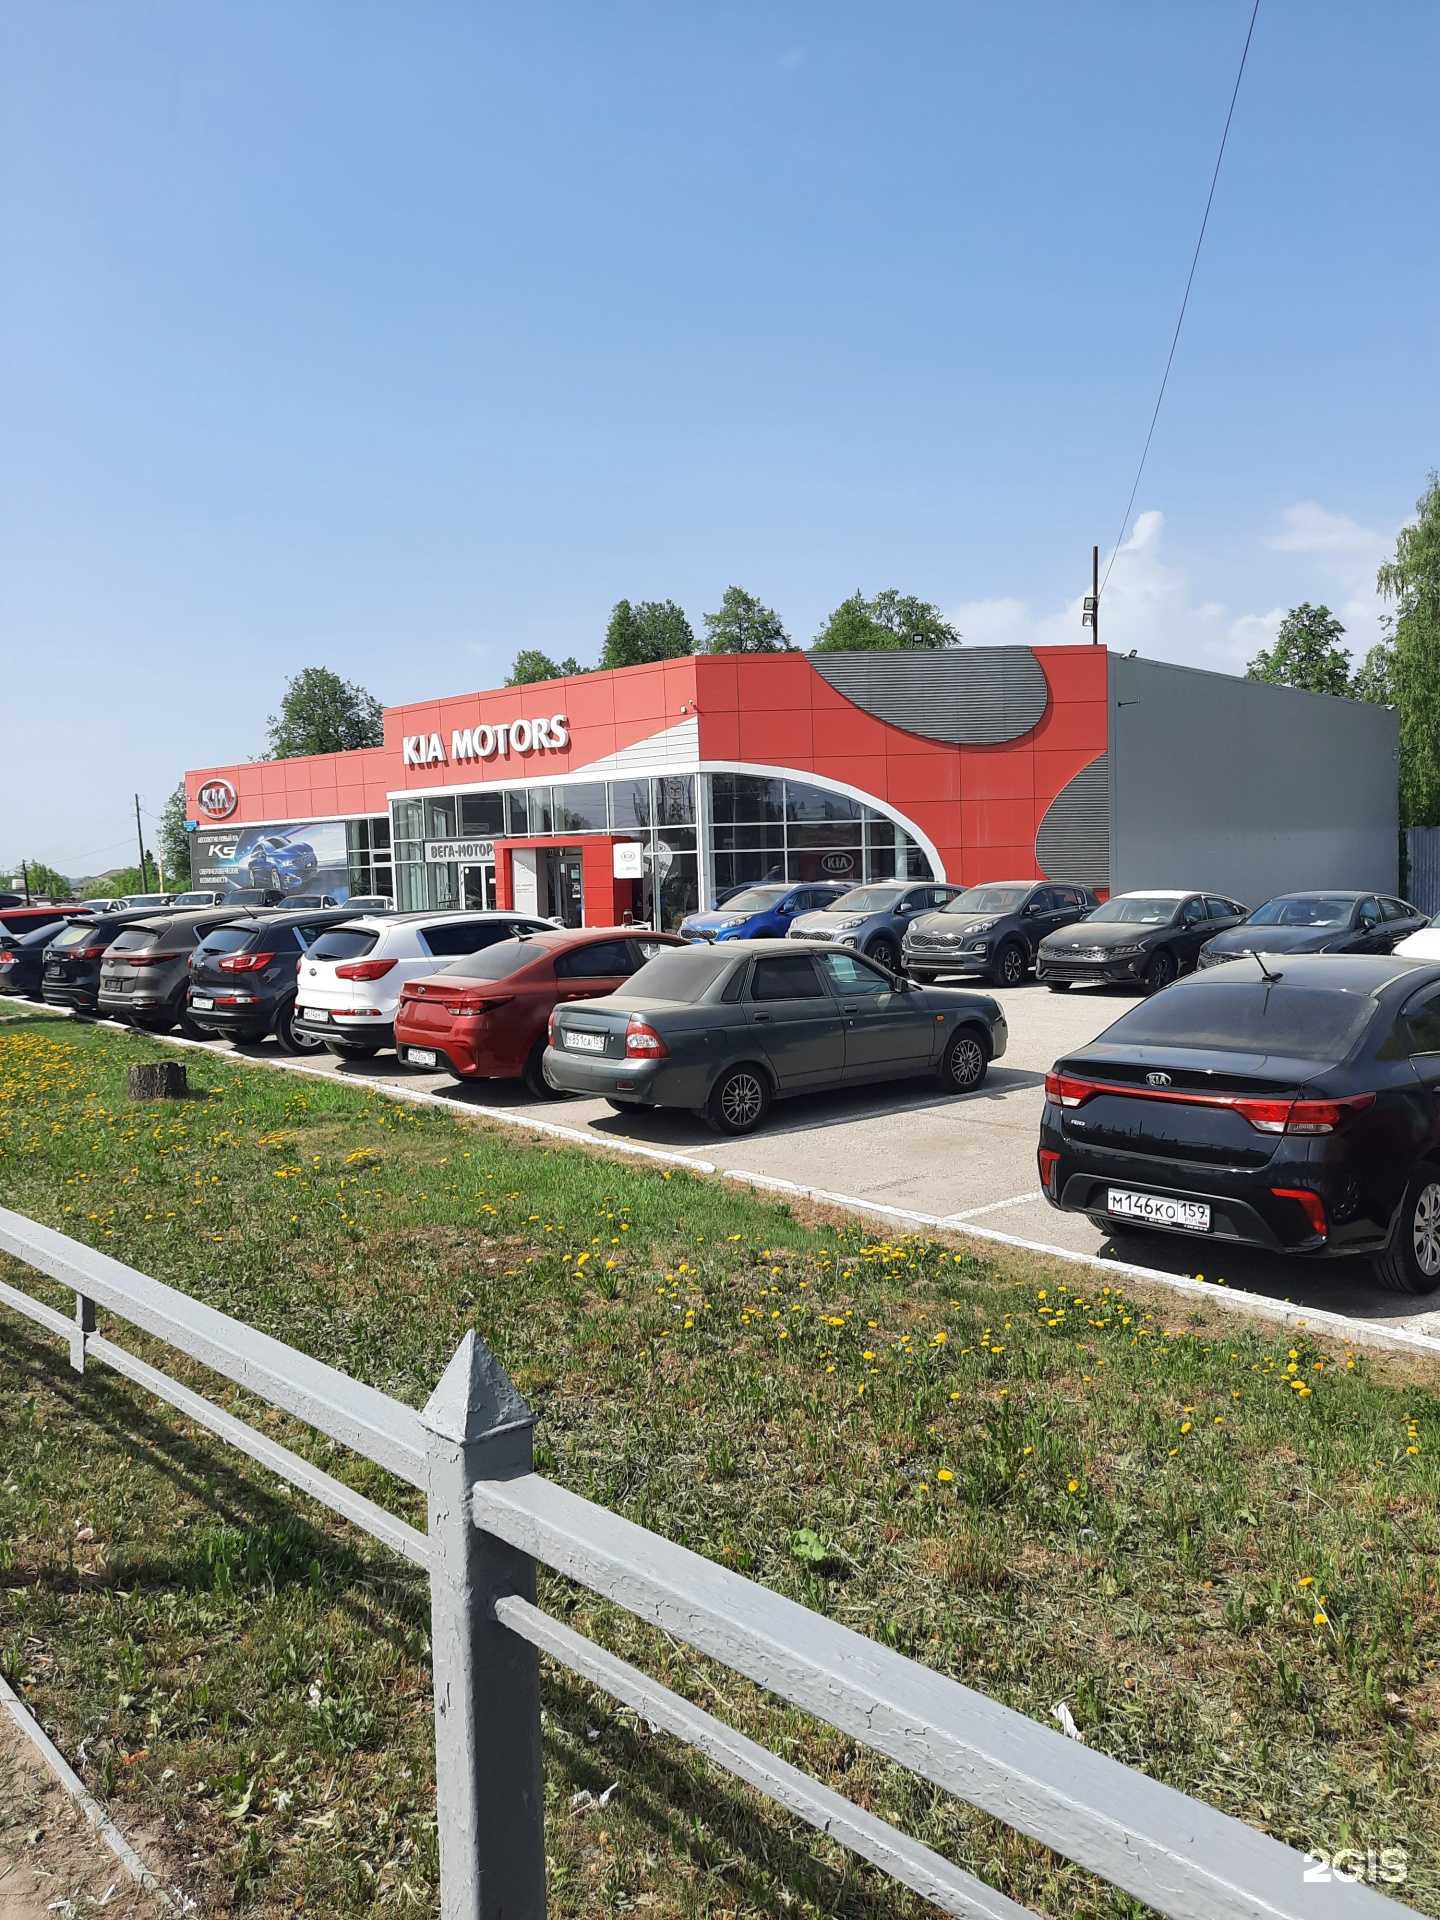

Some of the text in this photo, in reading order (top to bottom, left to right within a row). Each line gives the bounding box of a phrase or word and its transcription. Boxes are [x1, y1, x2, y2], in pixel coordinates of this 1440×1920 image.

[402, 714, 571, 764] KIA MOTORS
[202, 788, 229, 808] KIA
[827, 857, 848, 868] KIA
